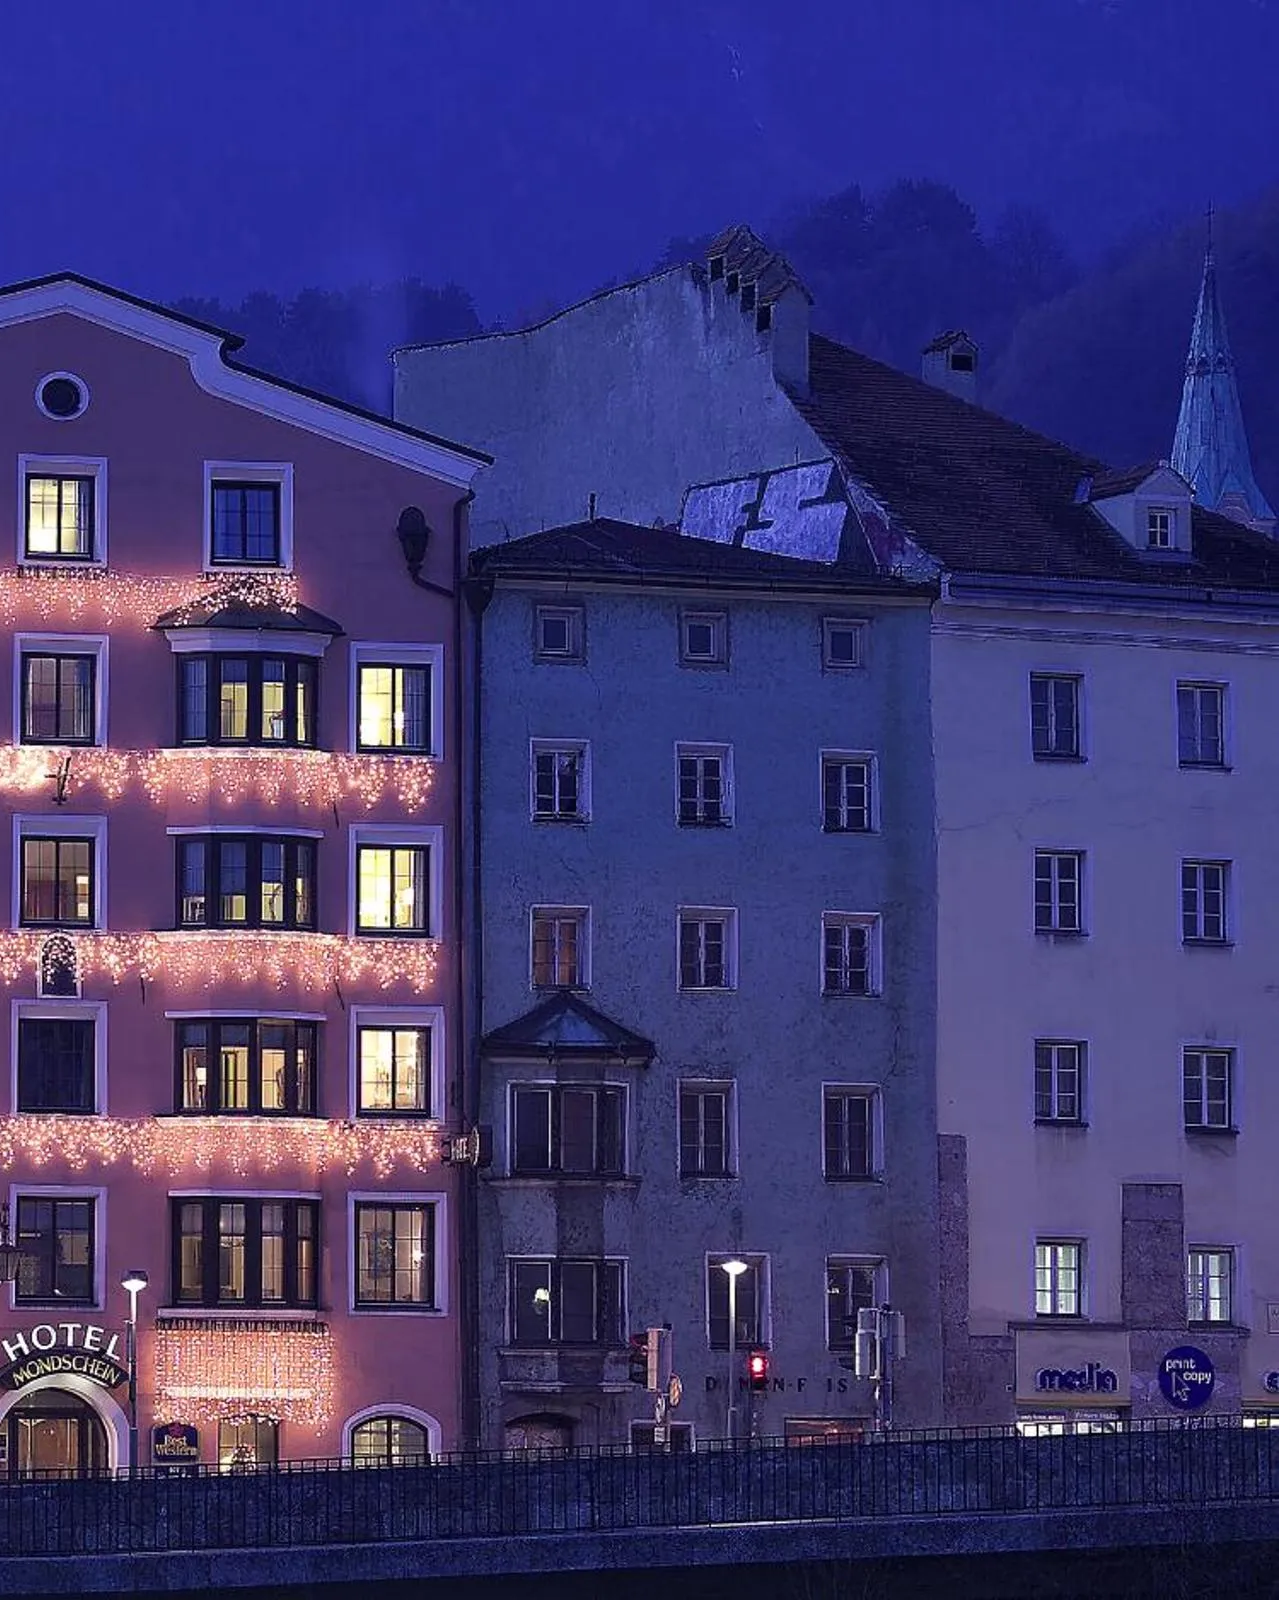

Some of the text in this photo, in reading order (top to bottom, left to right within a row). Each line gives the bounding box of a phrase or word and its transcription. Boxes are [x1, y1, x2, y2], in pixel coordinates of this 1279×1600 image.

[1, 1323, 121, 1362] HOTEL
[12, 1354, 120, 1387] MONDSCHEIN
[1035, 1362, 1118, 1392] media
[1165, 1358, 1196, 1372] print
[1183, 1371, 1212, 1384] copy
